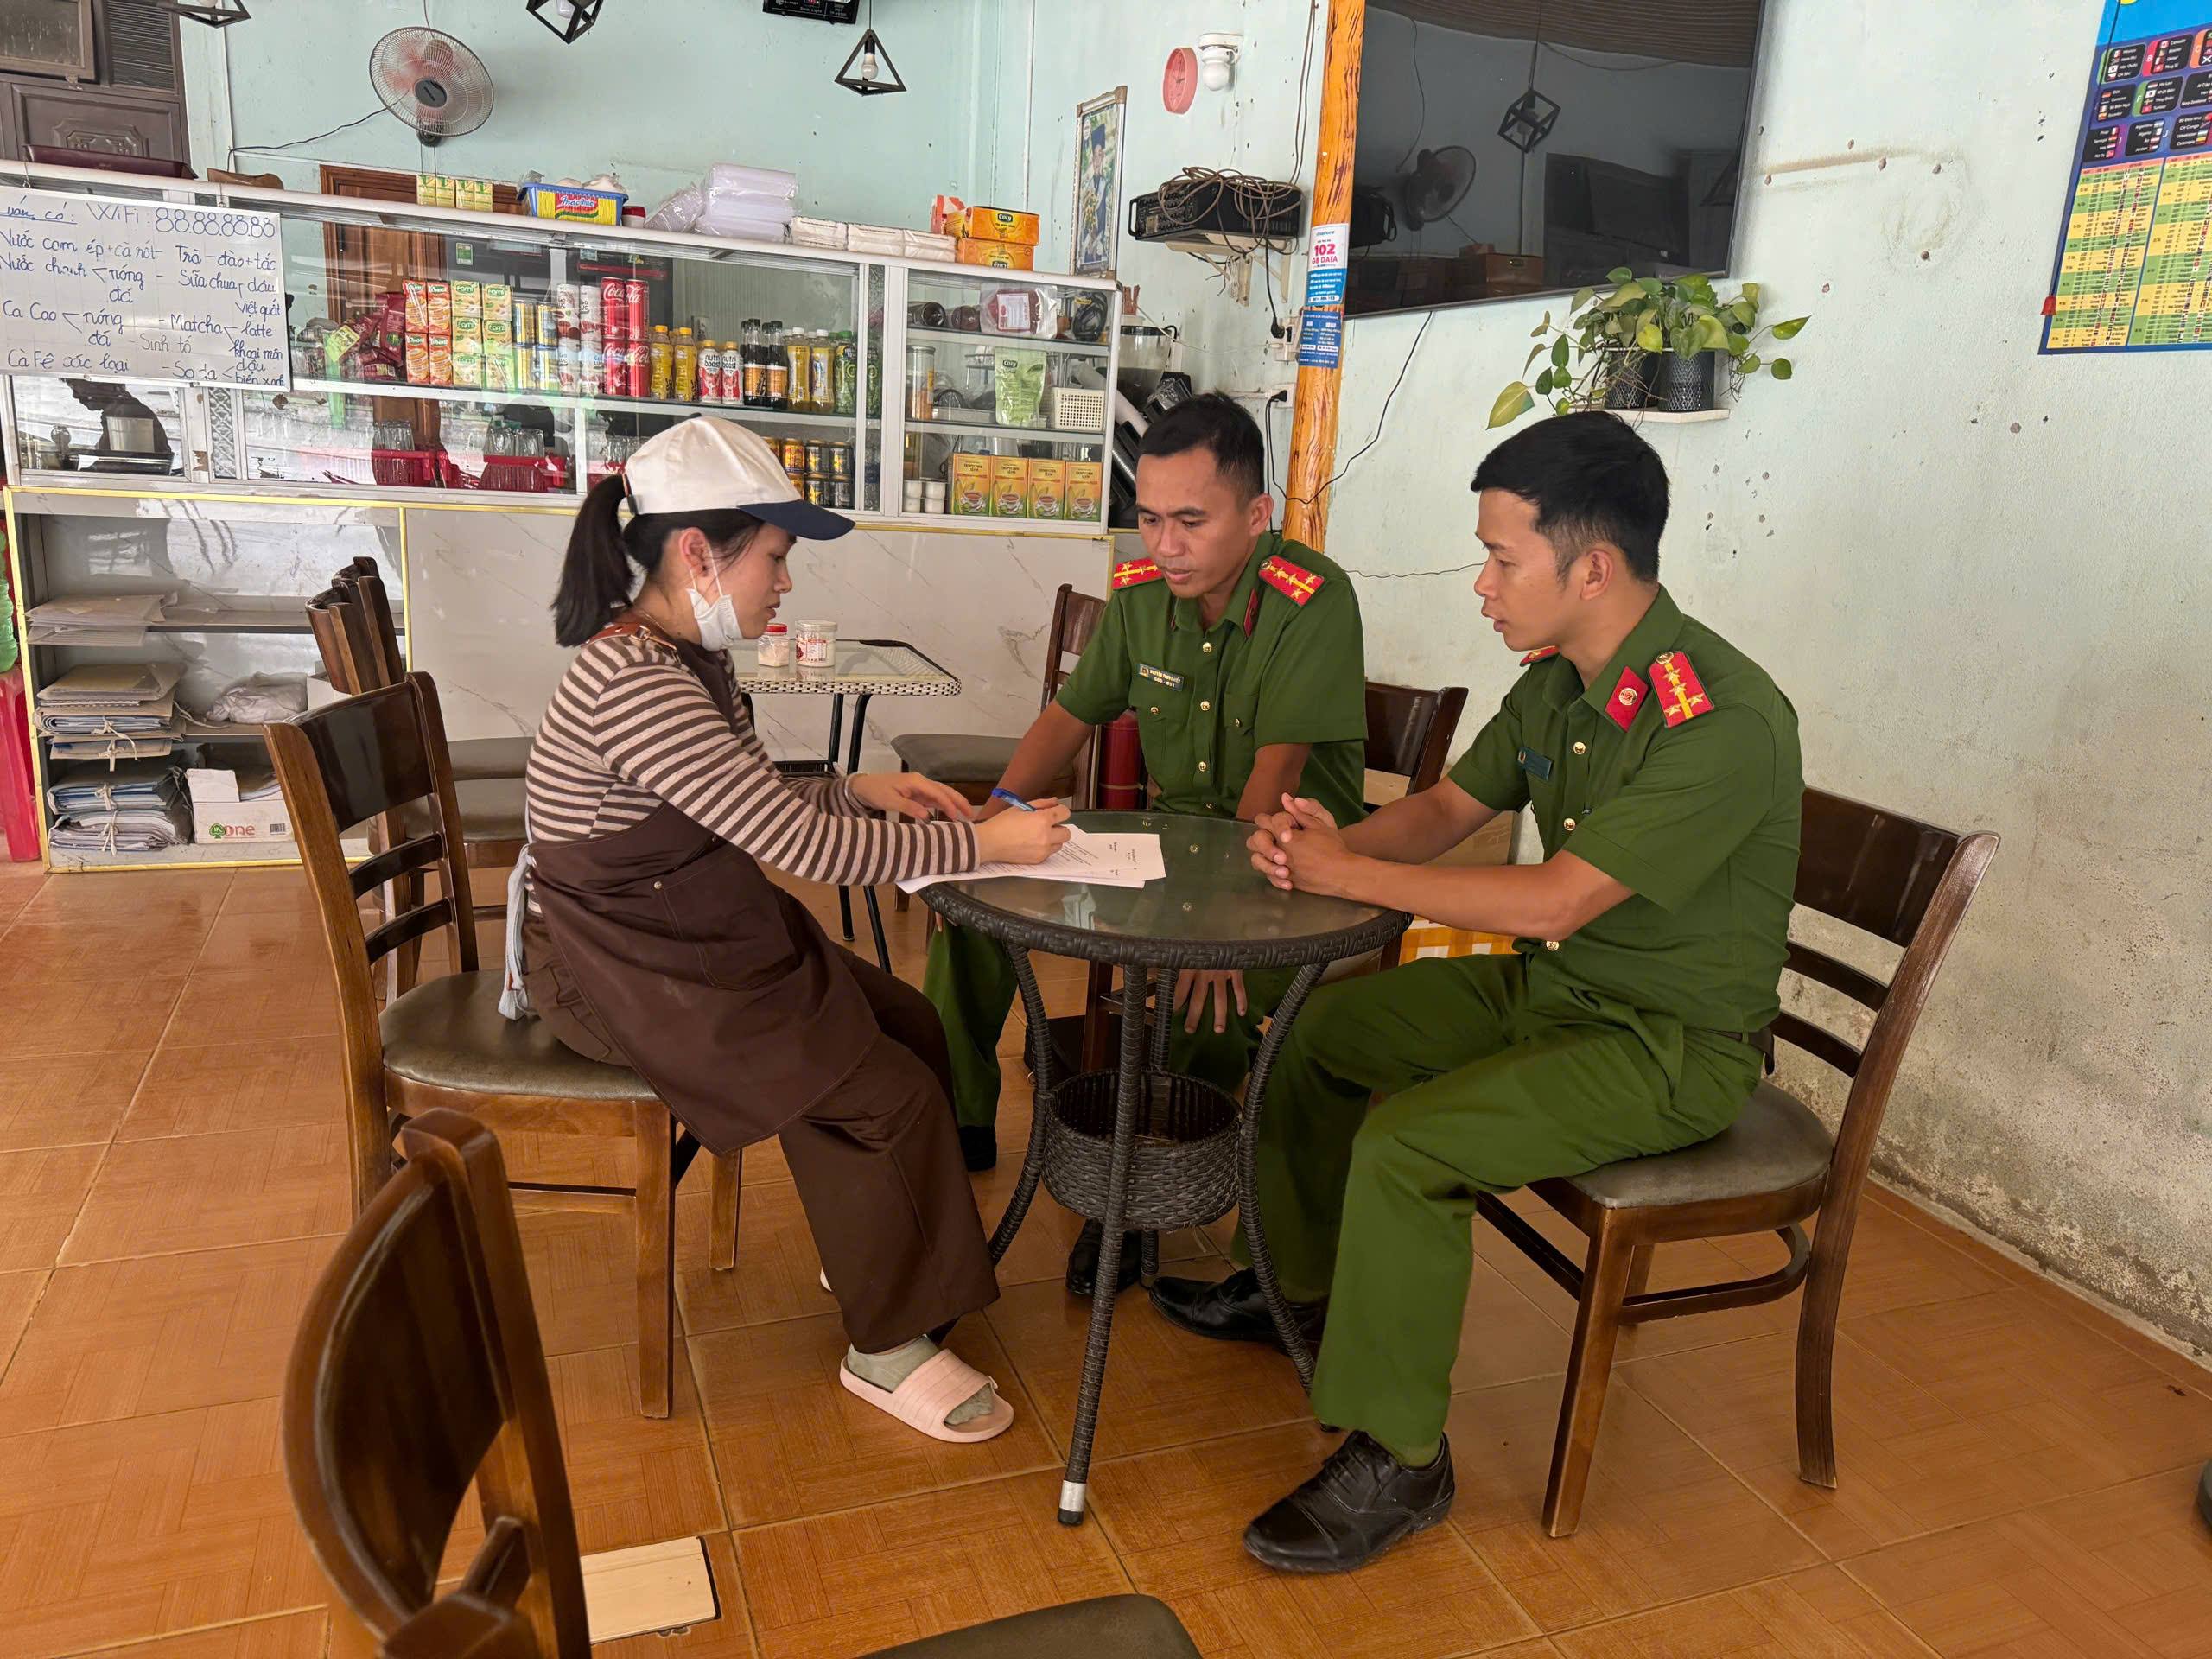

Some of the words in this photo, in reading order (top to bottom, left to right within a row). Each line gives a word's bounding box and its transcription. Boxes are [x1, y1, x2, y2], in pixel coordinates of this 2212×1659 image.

[1314, 244, 1336, 256] 102
[109, 264, 144, 291] nóng
[83, 308, 123, 335] nóng
[171, 314, 223, 334] Matcha
[241, 321, 273, 337] latte
[140, 333, 169, 353] Sinh
